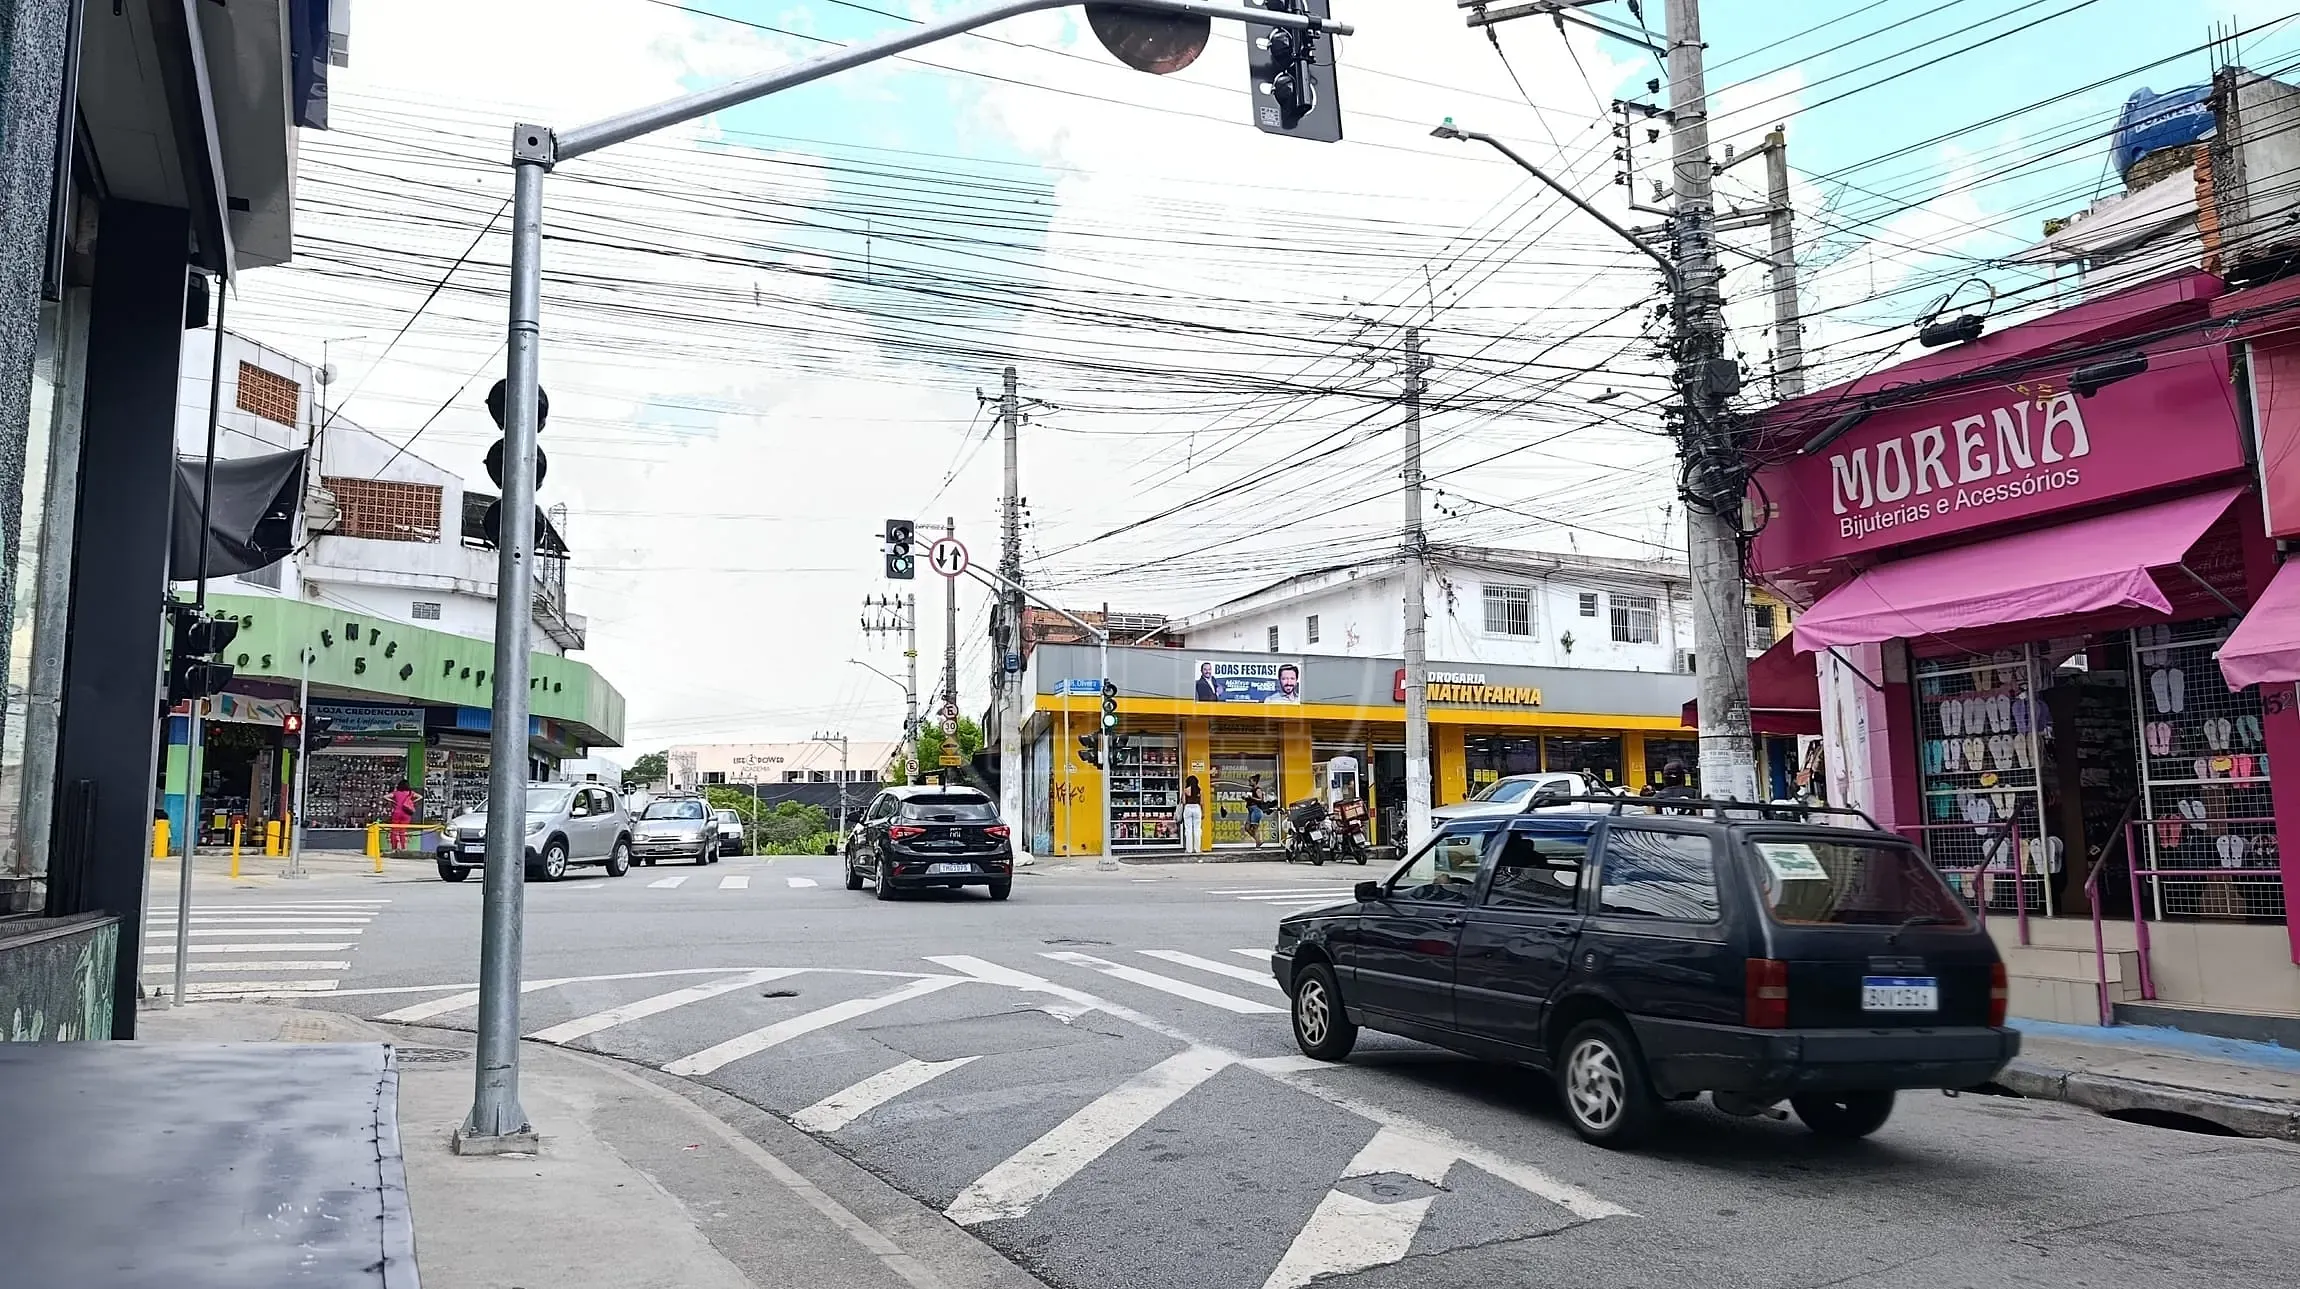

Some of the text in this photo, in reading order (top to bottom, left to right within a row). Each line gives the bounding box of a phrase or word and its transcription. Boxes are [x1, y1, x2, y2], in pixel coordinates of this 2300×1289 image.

[1829, 392, 2092, 514] MORENA
[1840, 466, 2080, 540] Bijuterias e Acessórios
[1215, 664, 1276, 676] BOAS FESTAS!
[1427, 671, 1485, 684] DROGARIA
[1426, 683, 1541, 705] NATHYFARMA
[317, 706, 415, 717] LOJA CREDENCIADA
